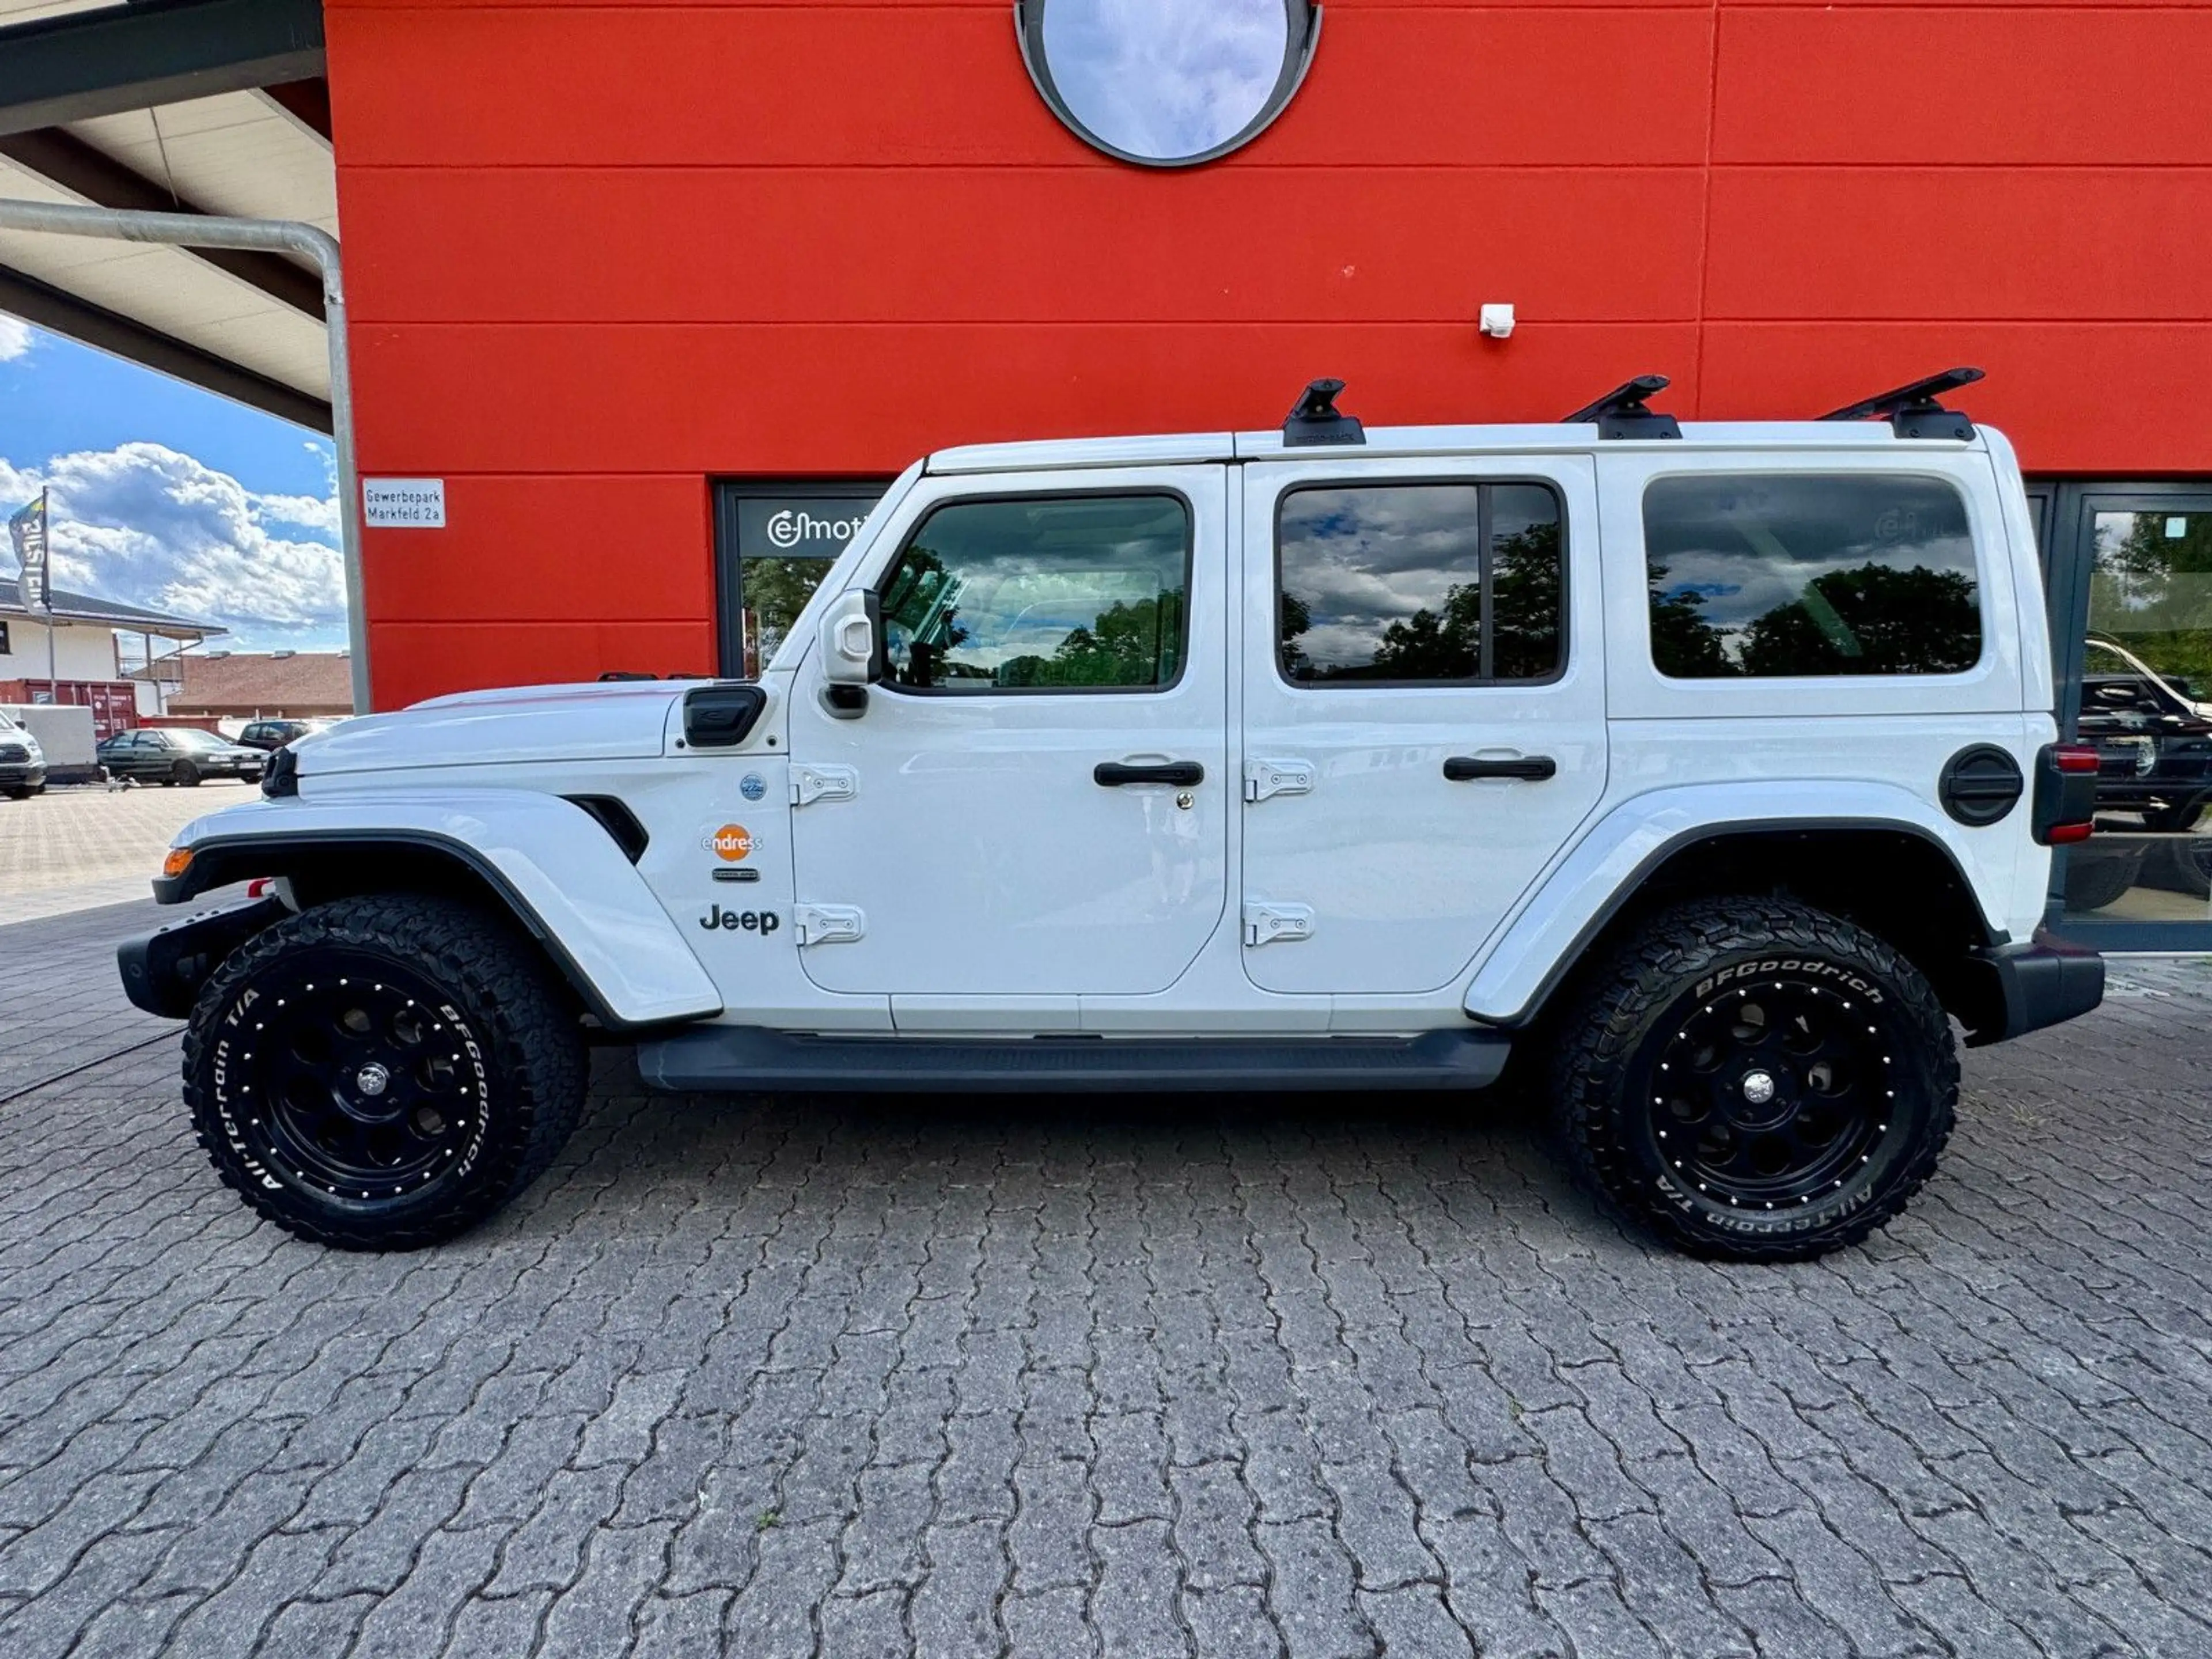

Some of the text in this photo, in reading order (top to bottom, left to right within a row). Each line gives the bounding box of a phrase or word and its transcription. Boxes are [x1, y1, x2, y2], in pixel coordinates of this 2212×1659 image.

[367, 490, 440, 506] Gewerbepark
[368, 507, 440, 520] Markfeld 2a
[701, 834, 764, 851] endress
[699, 904, 779, 935] Jeep
[1696, 960, 1884, 1003] BFGoodrich
[225, 988, 260, 1027] T/A
[440, 1005, 489, 1177] BFGoodrich
[213, 1040, 284, 1190] All-Terrain
